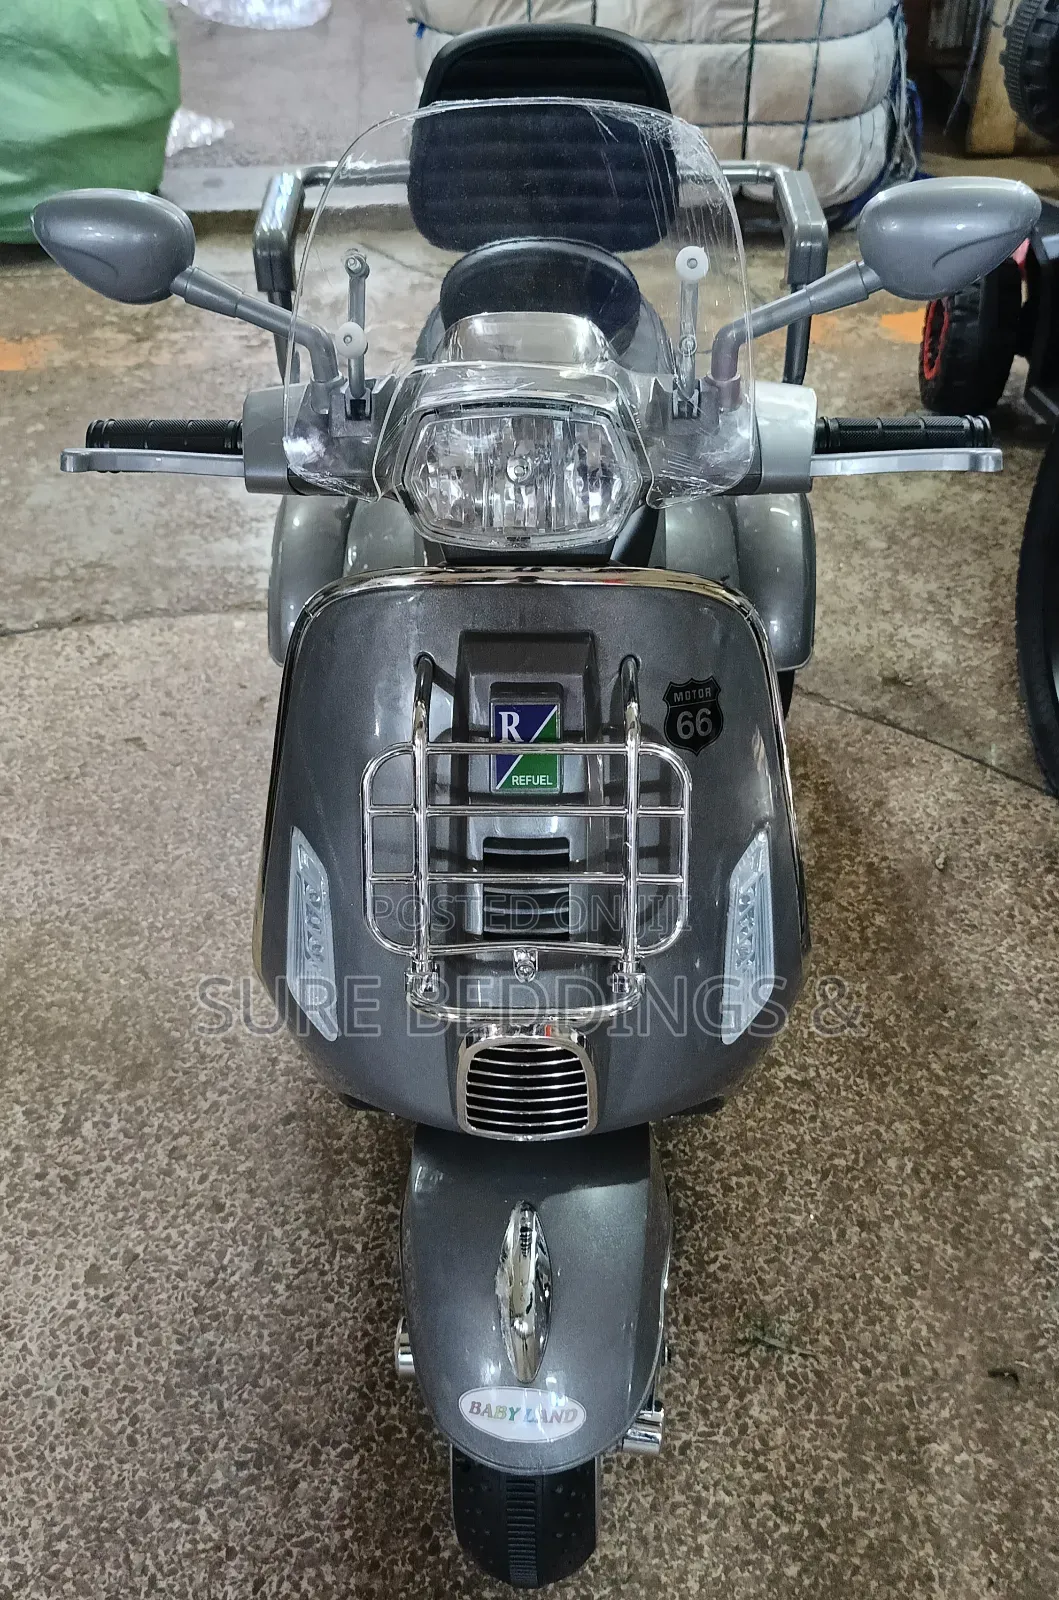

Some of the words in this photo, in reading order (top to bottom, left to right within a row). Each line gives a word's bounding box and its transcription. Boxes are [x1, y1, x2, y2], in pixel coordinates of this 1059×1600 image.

[673, 687, 712, 703] MOTOR
[498, 711, 523, 742] R
[676, 707, 713, 740] 66
[511, 774, 553, 786] REFUEL
[468, 1401, 521, 1422] BABY
[523, 1407, 579, 1424] LAND
